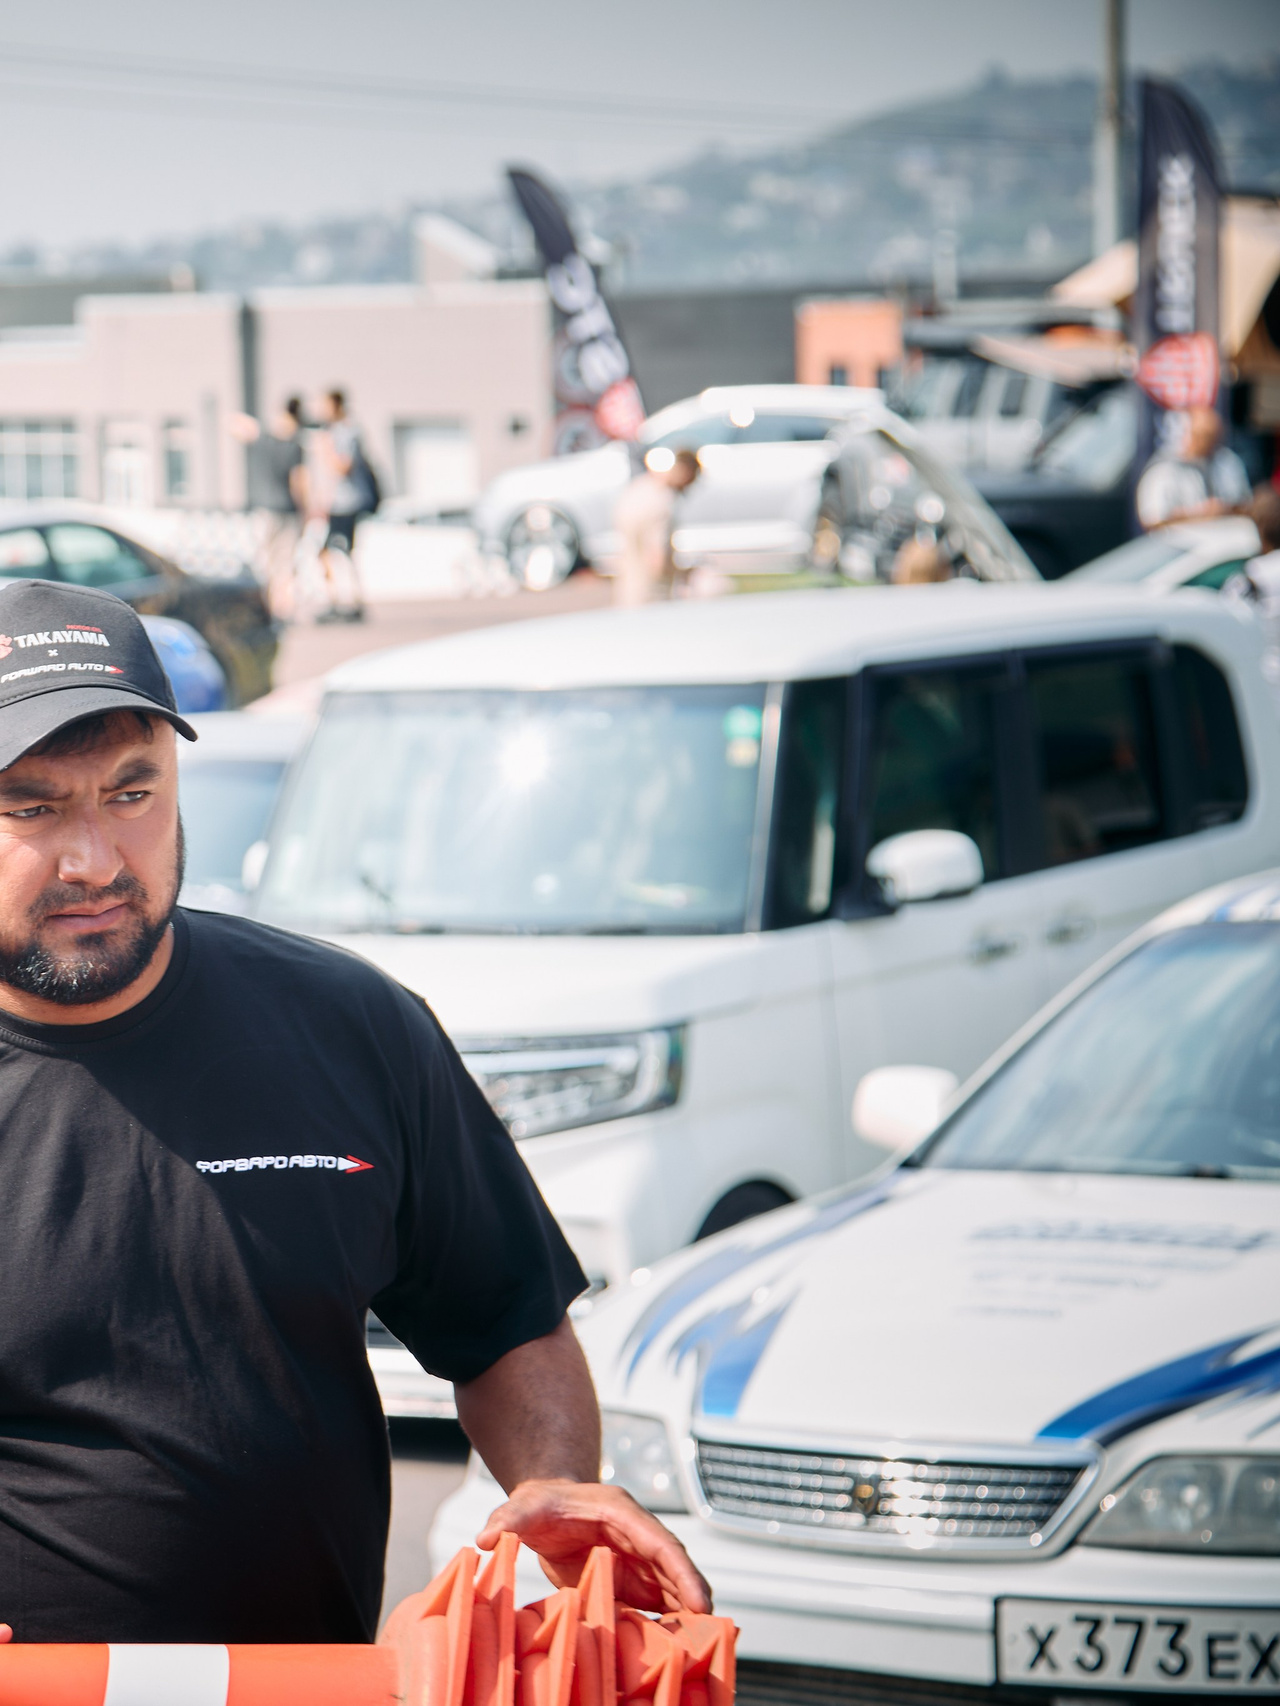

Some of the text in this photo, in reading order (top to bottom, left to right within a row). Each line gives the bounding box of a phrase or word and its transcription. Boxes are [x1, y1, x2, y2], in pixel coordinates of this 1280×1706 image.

[14, 630, 110, 648] TAKAYAMA
[1, 663, 104, 684] FORWARD AUTO
